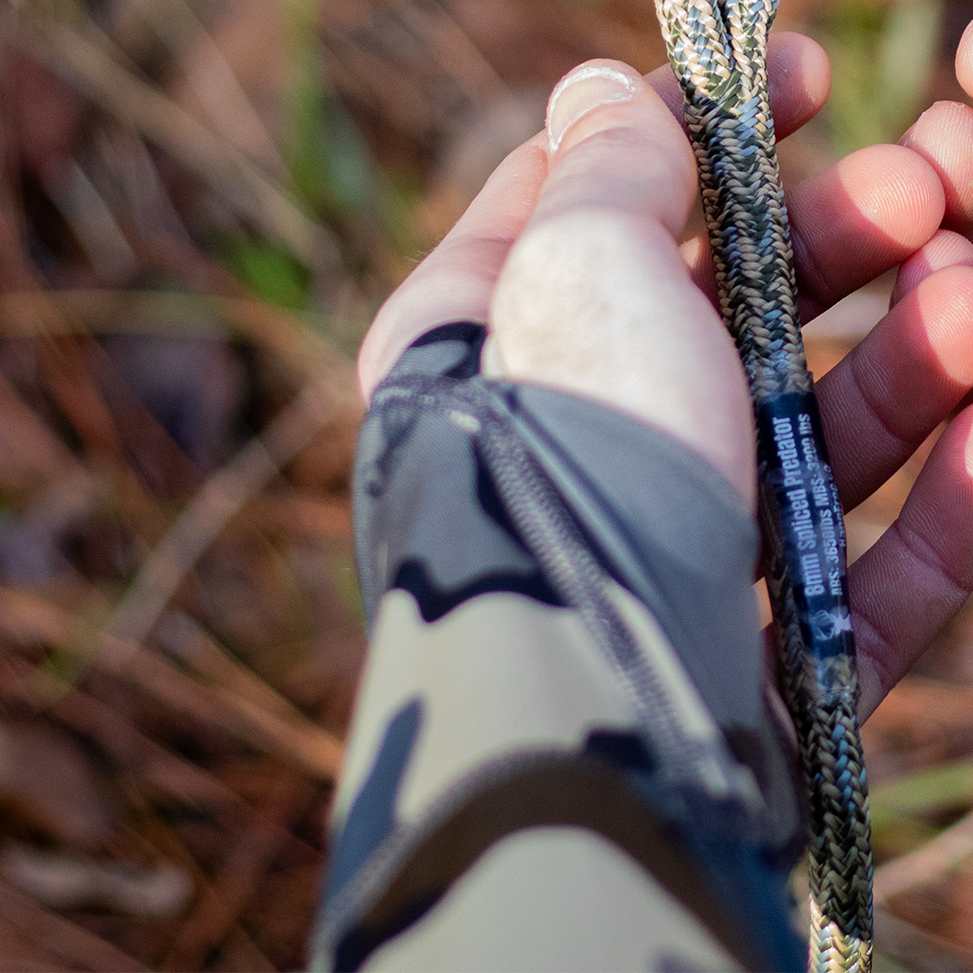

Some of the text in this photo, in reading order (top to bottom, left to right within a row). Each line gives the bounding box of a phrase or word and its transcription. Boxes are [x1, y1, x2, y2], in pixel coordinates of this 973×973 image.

[798, 413, 813, 435] lbs
[801, 438, 820, 471] 3200
[772, 417, 825, 596] 8mm Spliced Predator
[820, 509, 839, 564] 3650lbs
[828, 568, 843, 596] ABS:
